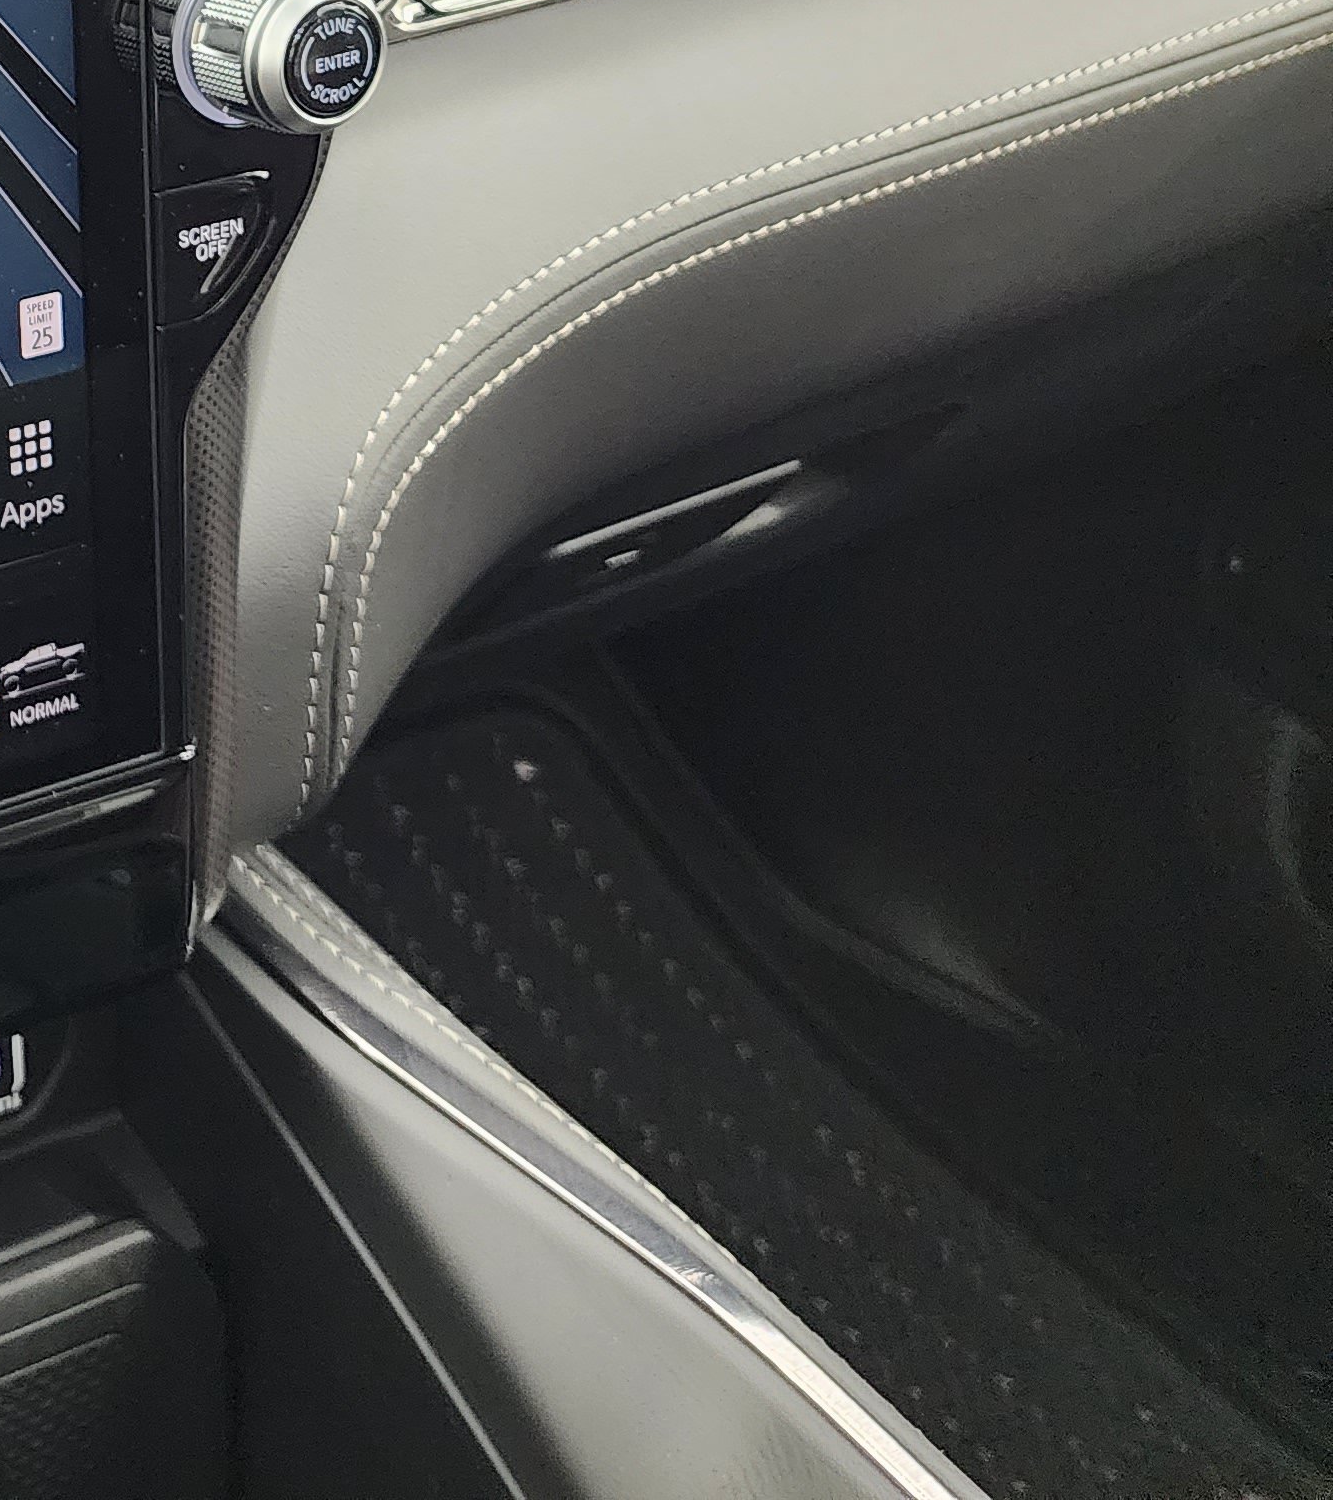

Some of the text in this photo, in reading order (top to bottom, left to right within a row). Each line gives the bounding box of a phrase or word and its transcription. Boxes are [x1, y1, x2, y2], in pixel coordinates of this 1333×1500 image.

[313, 16, 357, 42] TUNE
[314, 49, 361, 74] ENTER
[310, 74, 366, 105] SCROLL
[178, 216, 245, 249] SCREEN
[195, 238, 229, 263] OFF
[26, 299, 55, 314] SPEED
[28, 311, 53, 326] LIMIT
[31, 325, 53, 350] 25
[0, 493, 66, 530] Apps
[9, 692, 81, 729] NORMAL
